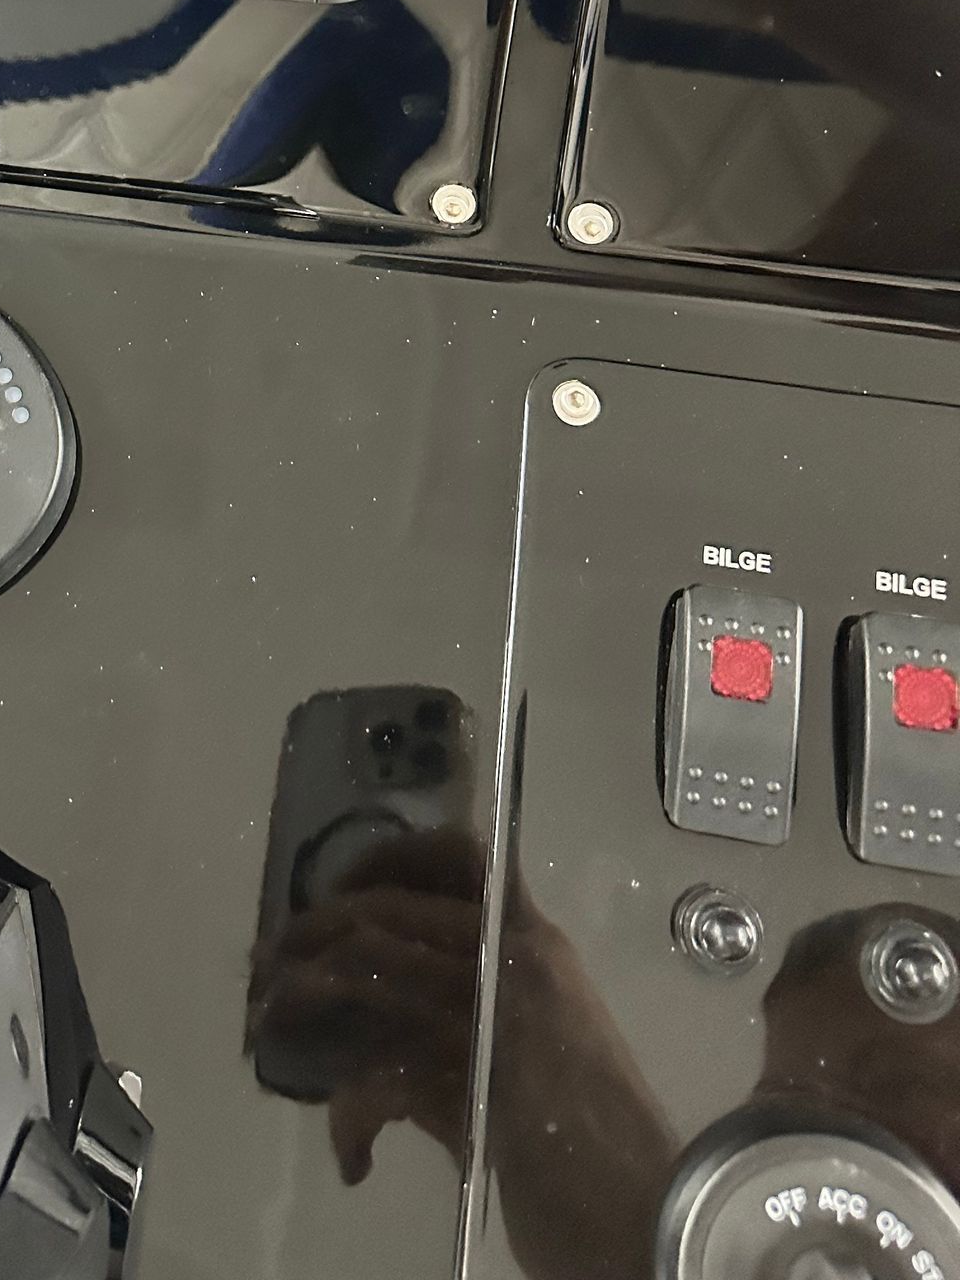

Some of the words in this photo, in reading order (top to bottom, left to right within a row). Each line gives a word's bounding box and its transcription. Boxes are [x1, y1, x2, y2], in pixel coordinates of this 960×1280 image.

[702, 544, 773, 574] BILGE
[875, 570, 948, 601] BILGE
[764, 1186, 807, 1223] OFF
[818, 1186, 868, 1220] ACC
[875, 1210, 913, 1250] ON
